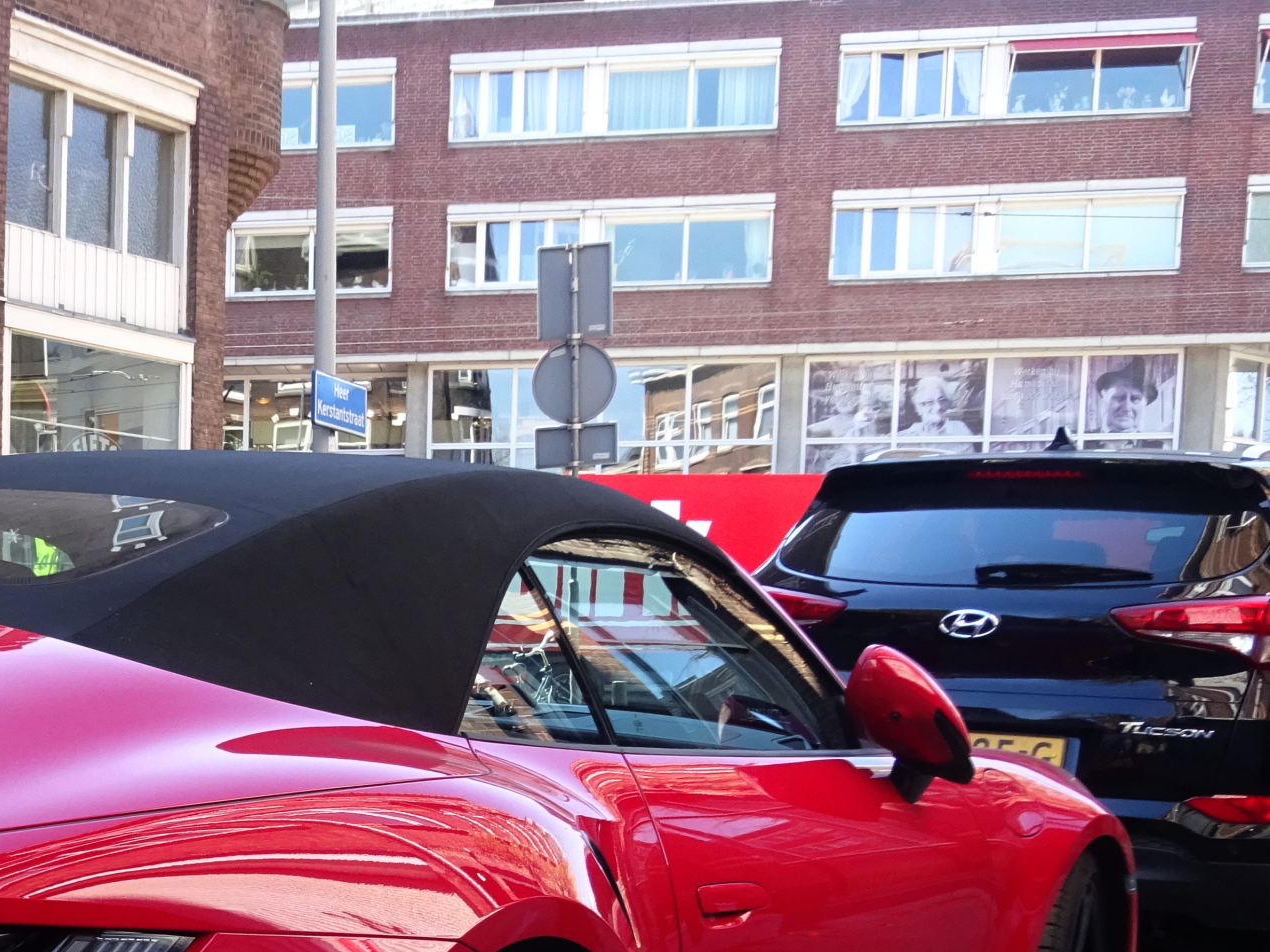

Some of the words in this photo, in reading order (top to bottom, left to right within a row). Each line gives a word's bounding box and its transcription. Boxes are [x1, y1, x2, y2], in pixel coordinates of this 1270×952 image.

[333, 382, 350, 401] Heer
[317, 399, 365, 428] Kerstantstraat
[1119, 721, 1216, 740] TUCSON
